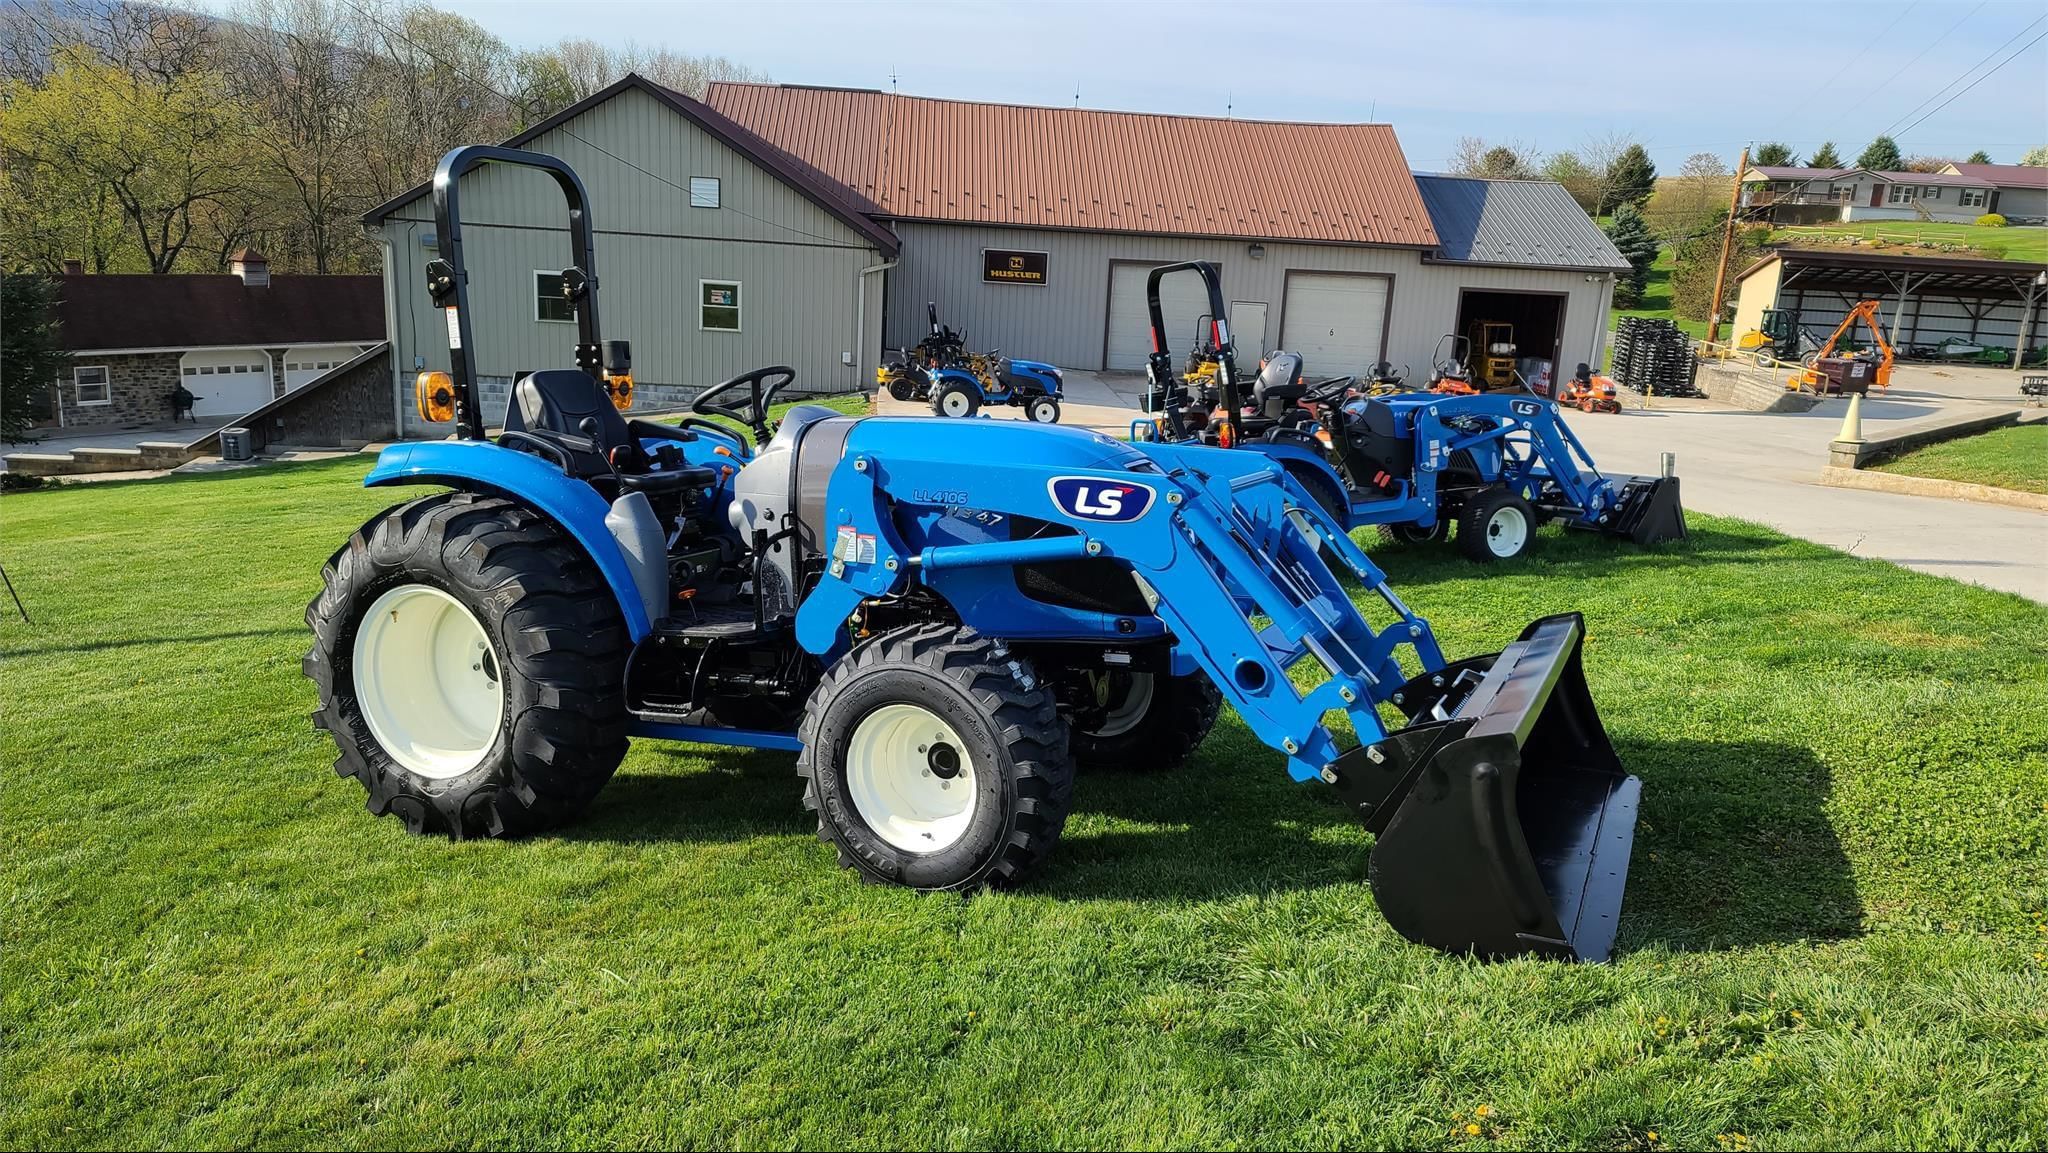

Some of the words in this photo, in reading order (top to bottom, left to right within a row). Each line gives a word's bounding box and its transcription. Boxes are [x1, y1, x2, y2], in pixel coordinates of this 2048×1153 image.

[990, 270, 1041, 279] HUSTLER
[1517, 403, 1534, 415] LS
[913, 489, 968, 505] LL4106
[1074, 486, 1124, 517] LS
